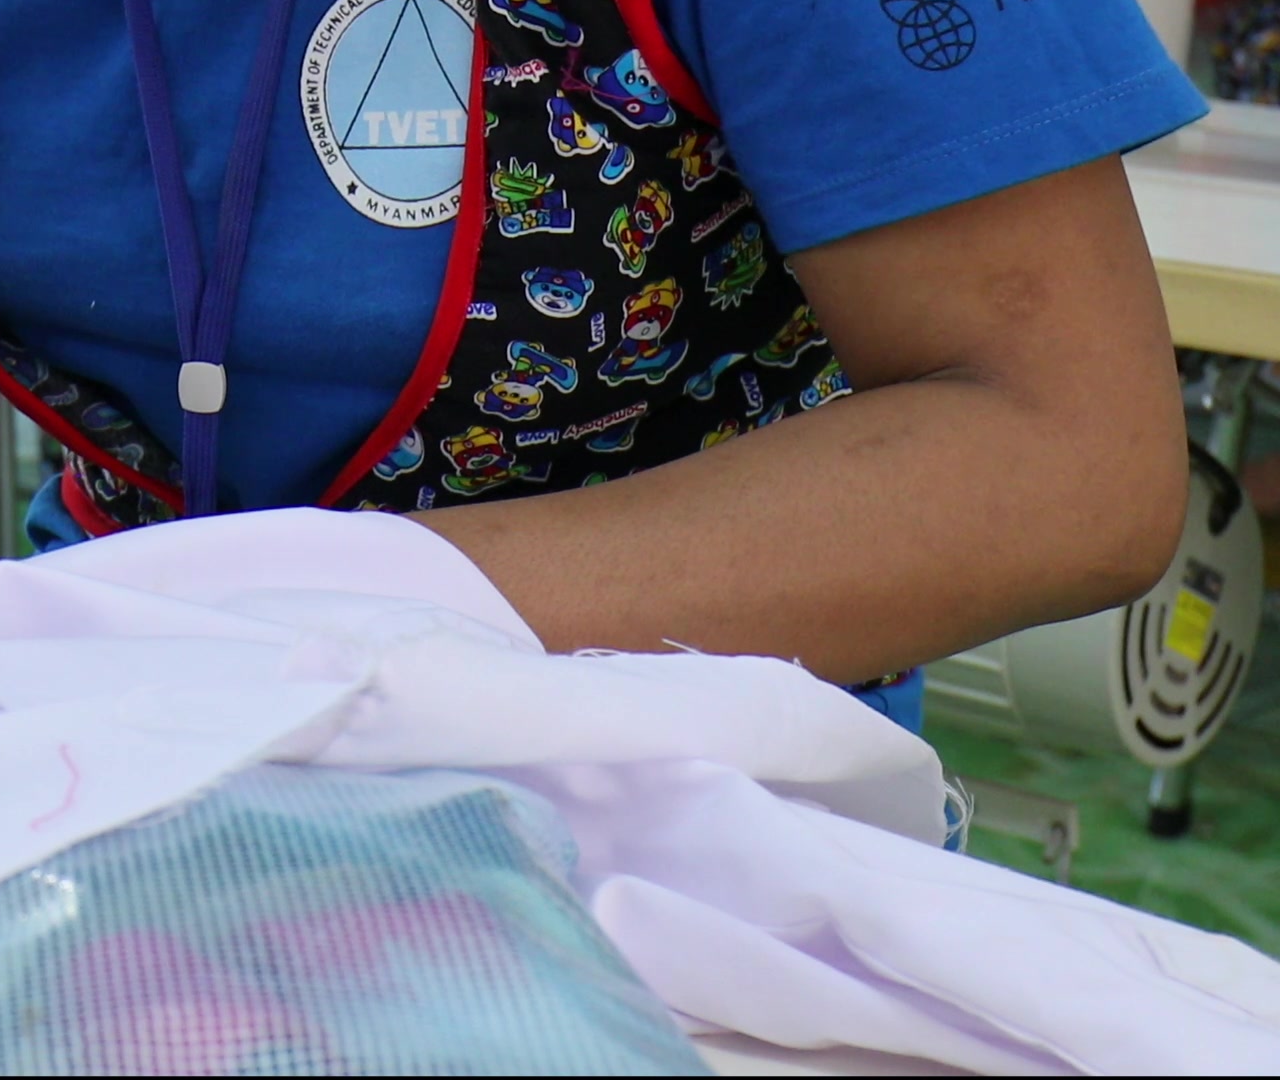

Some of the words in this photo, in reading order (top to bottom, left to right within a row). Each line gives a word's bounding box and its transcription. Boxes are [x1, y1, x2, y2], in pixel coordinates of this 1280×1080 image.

[307, 58, 322, 77] OF
[306, 79, 339, 165] DEPARTMENT
[363, 110, 463, 145] TVET
